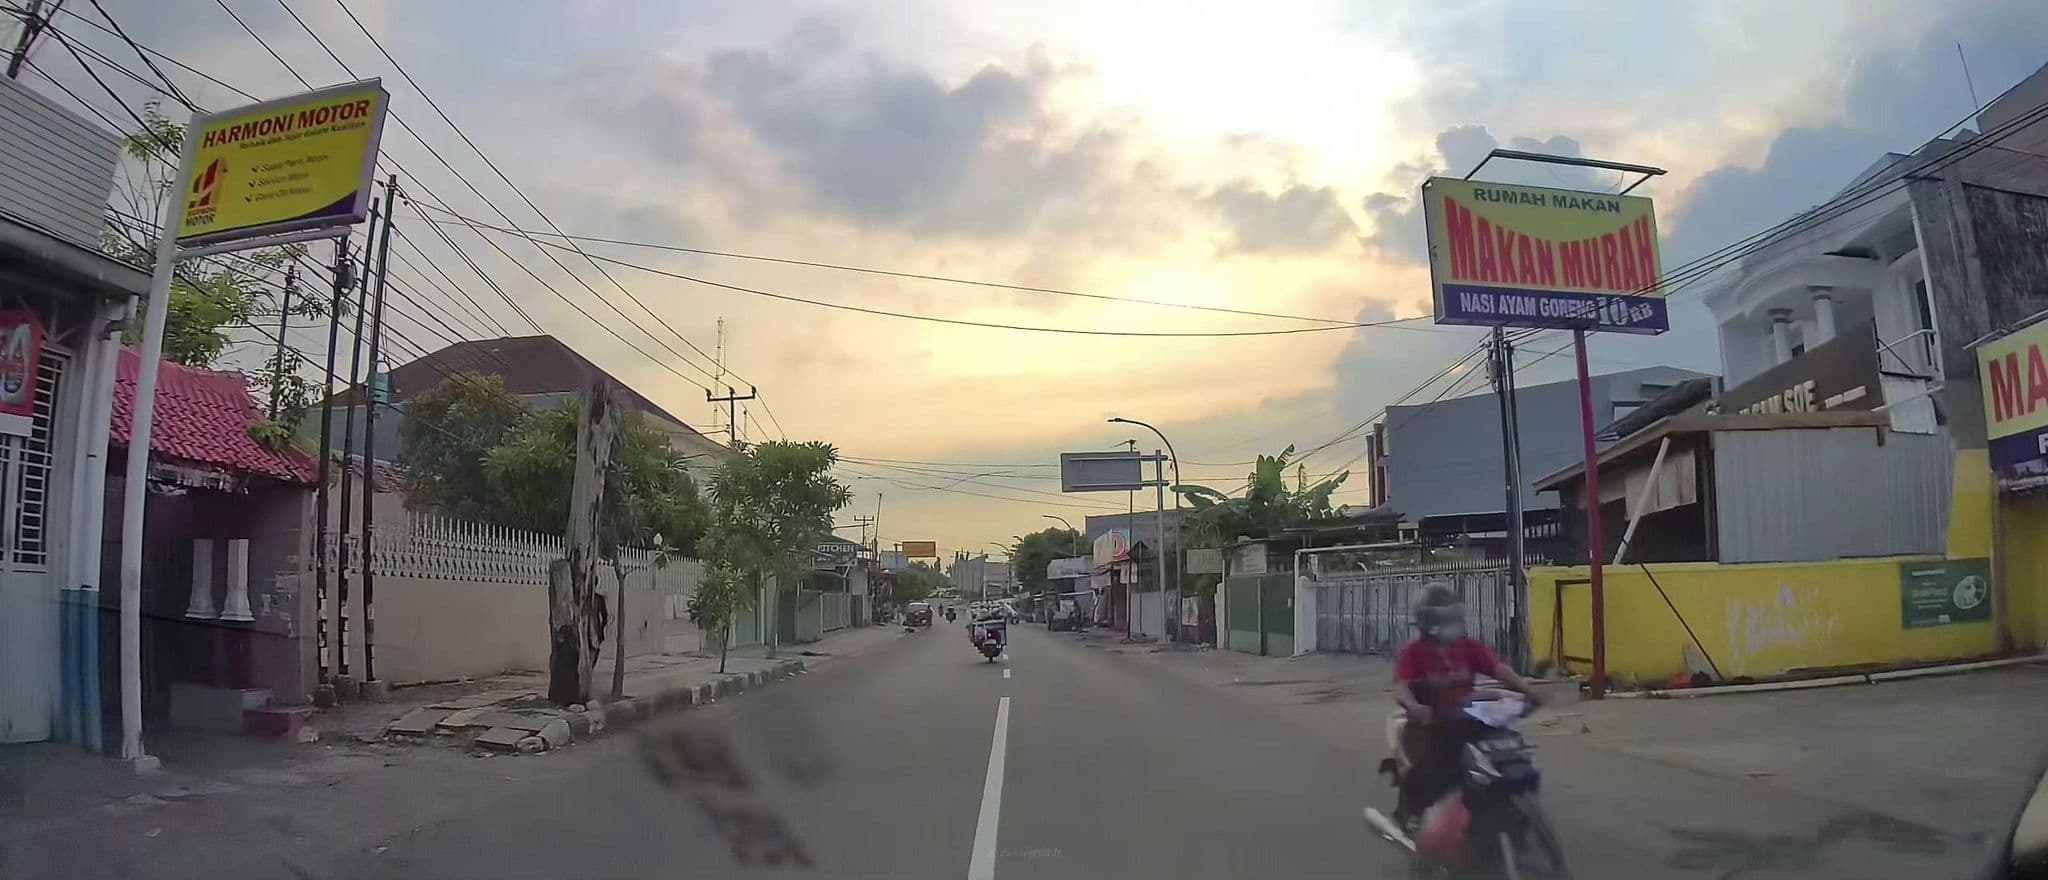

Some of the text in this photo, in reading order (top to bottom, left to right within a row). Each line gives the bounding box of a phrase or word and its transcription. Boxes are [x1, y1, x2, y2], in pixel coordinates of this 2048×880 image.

[202, 99, 371, 149] HARMONI MOTOR
[1473, 187, 1621, 214] RUMAH MAKAN
[1444, 195, 1658, 292] MAKAN MURAH
[1460, 292, 1495, 314] NASI
[1499, 293, 1536, 316] AYAM
[1539, 296, 1597, 320] GORENG
[817, 543, 855, 553] KITCHEN
